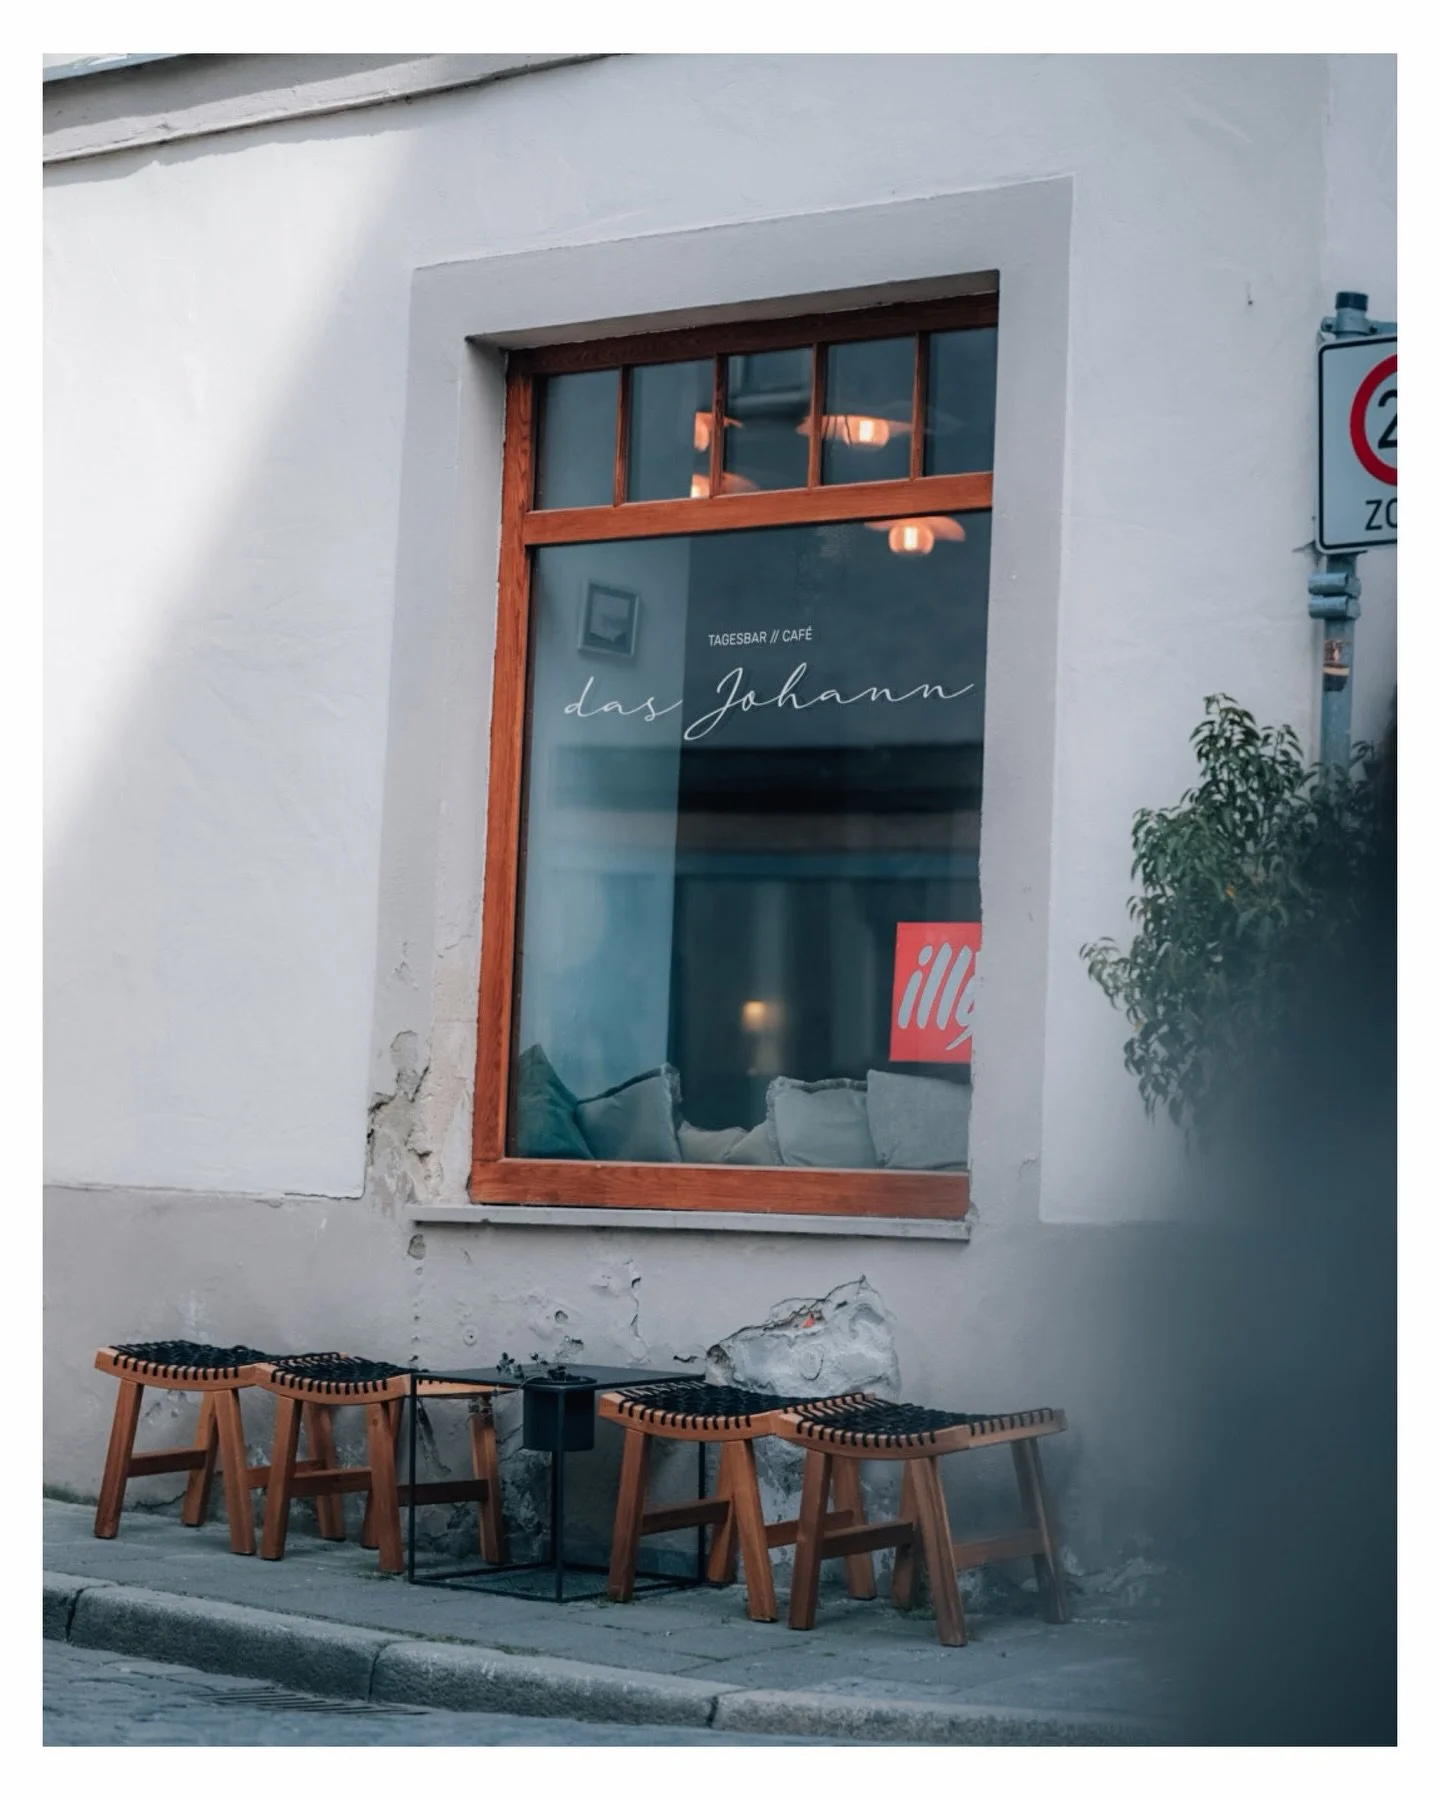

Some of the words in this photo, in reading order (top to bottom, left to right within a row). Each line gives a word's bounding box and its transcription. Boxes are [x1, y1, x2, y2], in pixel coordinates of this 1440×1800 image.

[708, 631, 767, 647] TAGESBAR
[782, 625, 813, 642] CAFÉ
[564, 676, 683, 722] das
[683, 661, 975, 741] Johann
